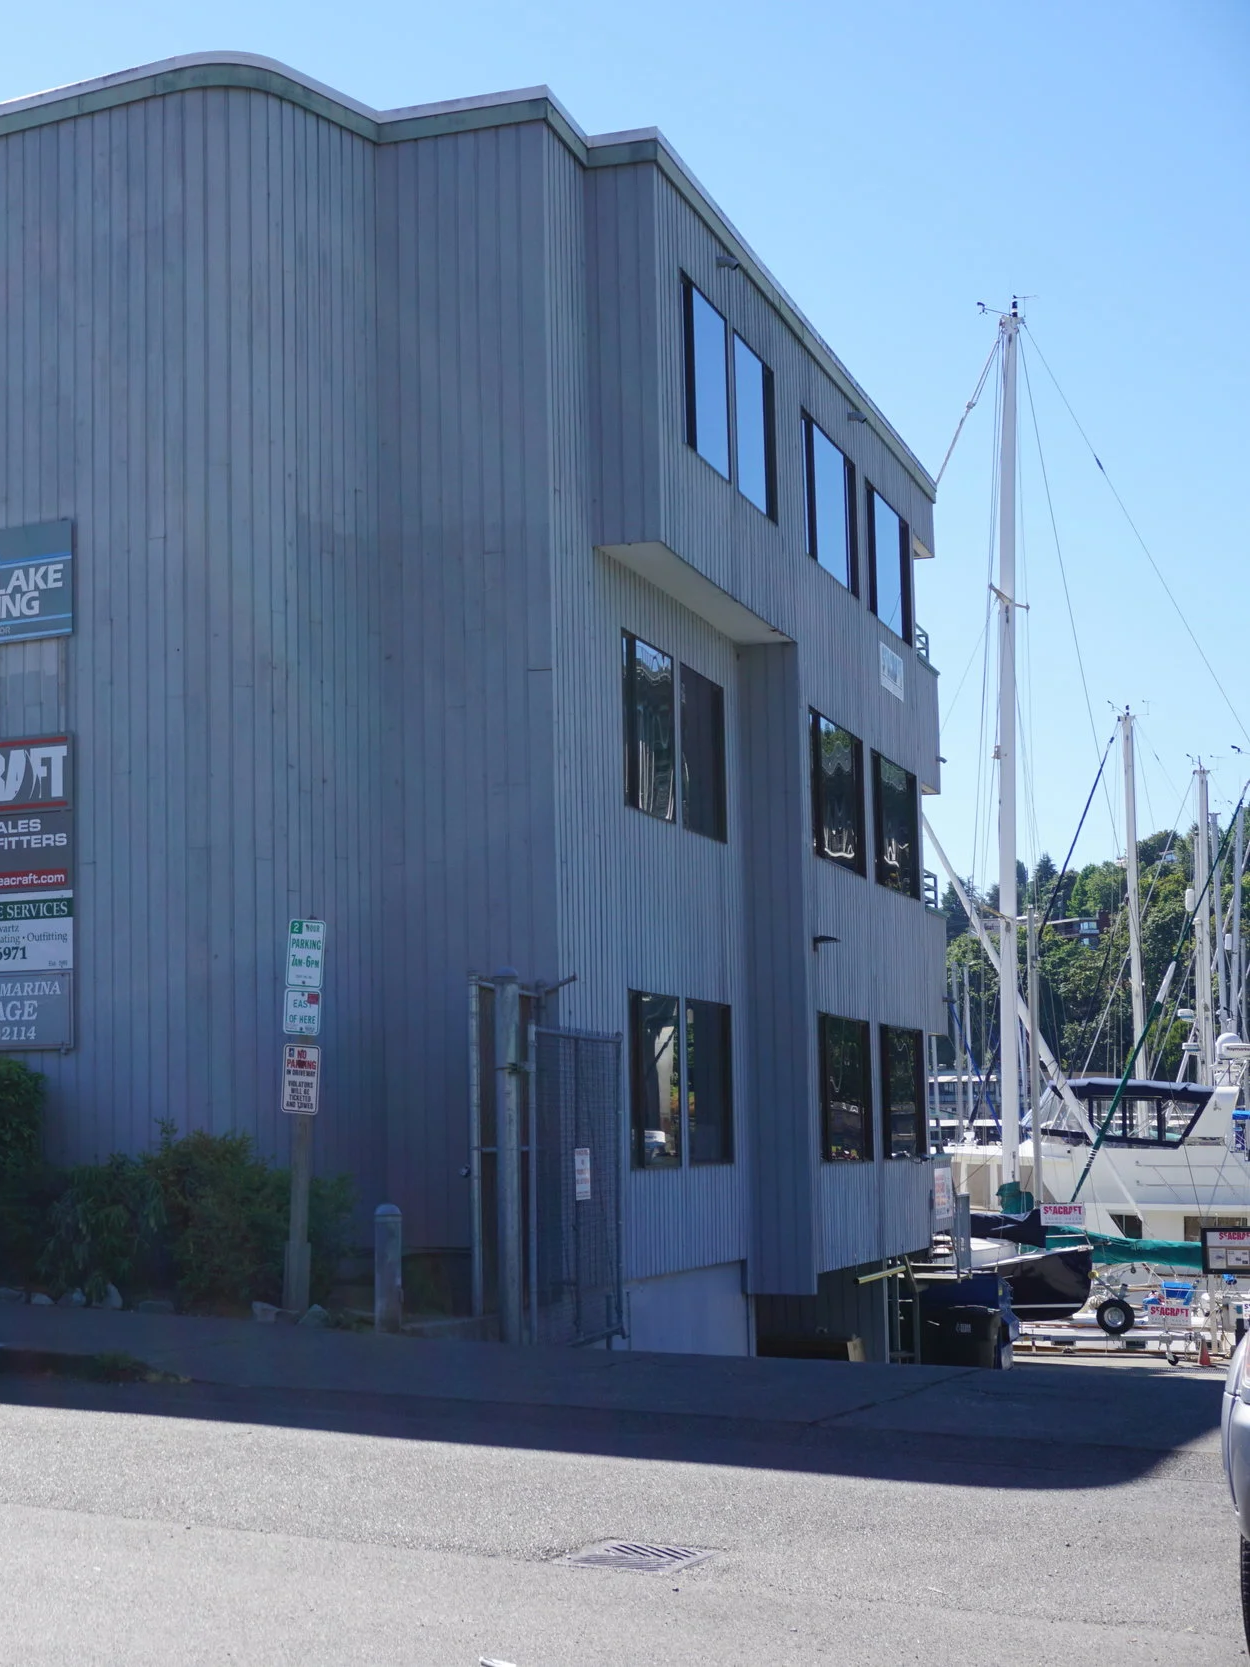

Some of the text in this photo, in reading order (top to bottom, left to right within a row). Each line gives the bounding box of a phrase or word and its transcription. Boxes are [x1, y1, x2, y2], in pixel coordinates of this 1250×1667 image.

[7, 901, 68, 919] SERVICES
[293, 923, 320, 933] 2 HOUR
[27, 931, 68, 943] Outfitting
[291, 938, 322, 951] PARKING
[0, 981, 61, 997] MARINA
[289, 1014, 316, 1025] OF HERE
[297, 1049, 307, 1059] NO
[286, 1059, 317, 1070] PARKING
[1043, 1206, 1082, 1215] SEACRAFT
[1219, 1232, 1250, 1240] SEACRAF
[1150, 1306, 1189, 1318] SEACRAFT
